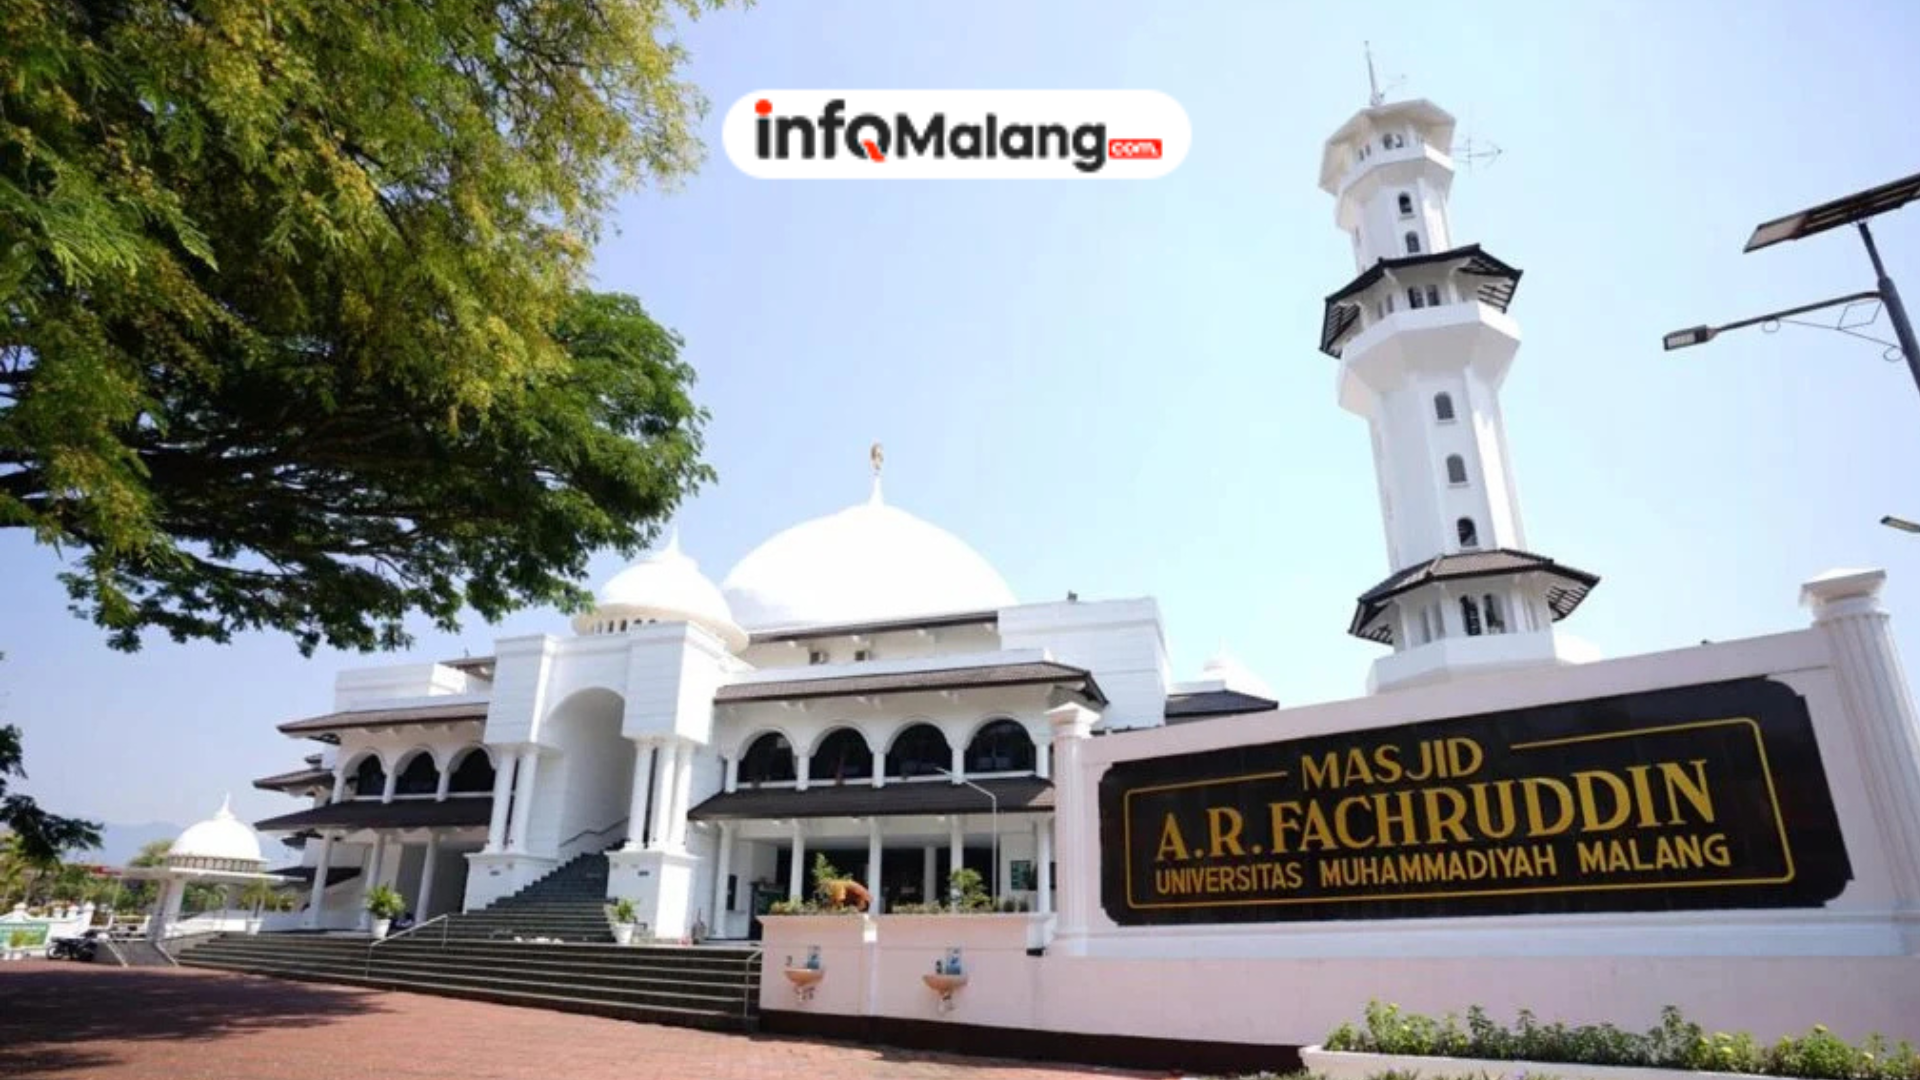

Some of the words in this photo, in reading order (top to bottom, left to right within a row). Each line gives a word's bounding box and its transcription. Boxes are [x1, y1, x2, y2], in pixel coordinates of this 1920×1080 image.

[1302, 737, 1482, 790] MASJID
[1155, 862, 1303, 895] UNIVERSITAS
[1320, 845, 1557, 887] MUHAMMADIYAH
[1577, 834, 1731, 873] MALANG
